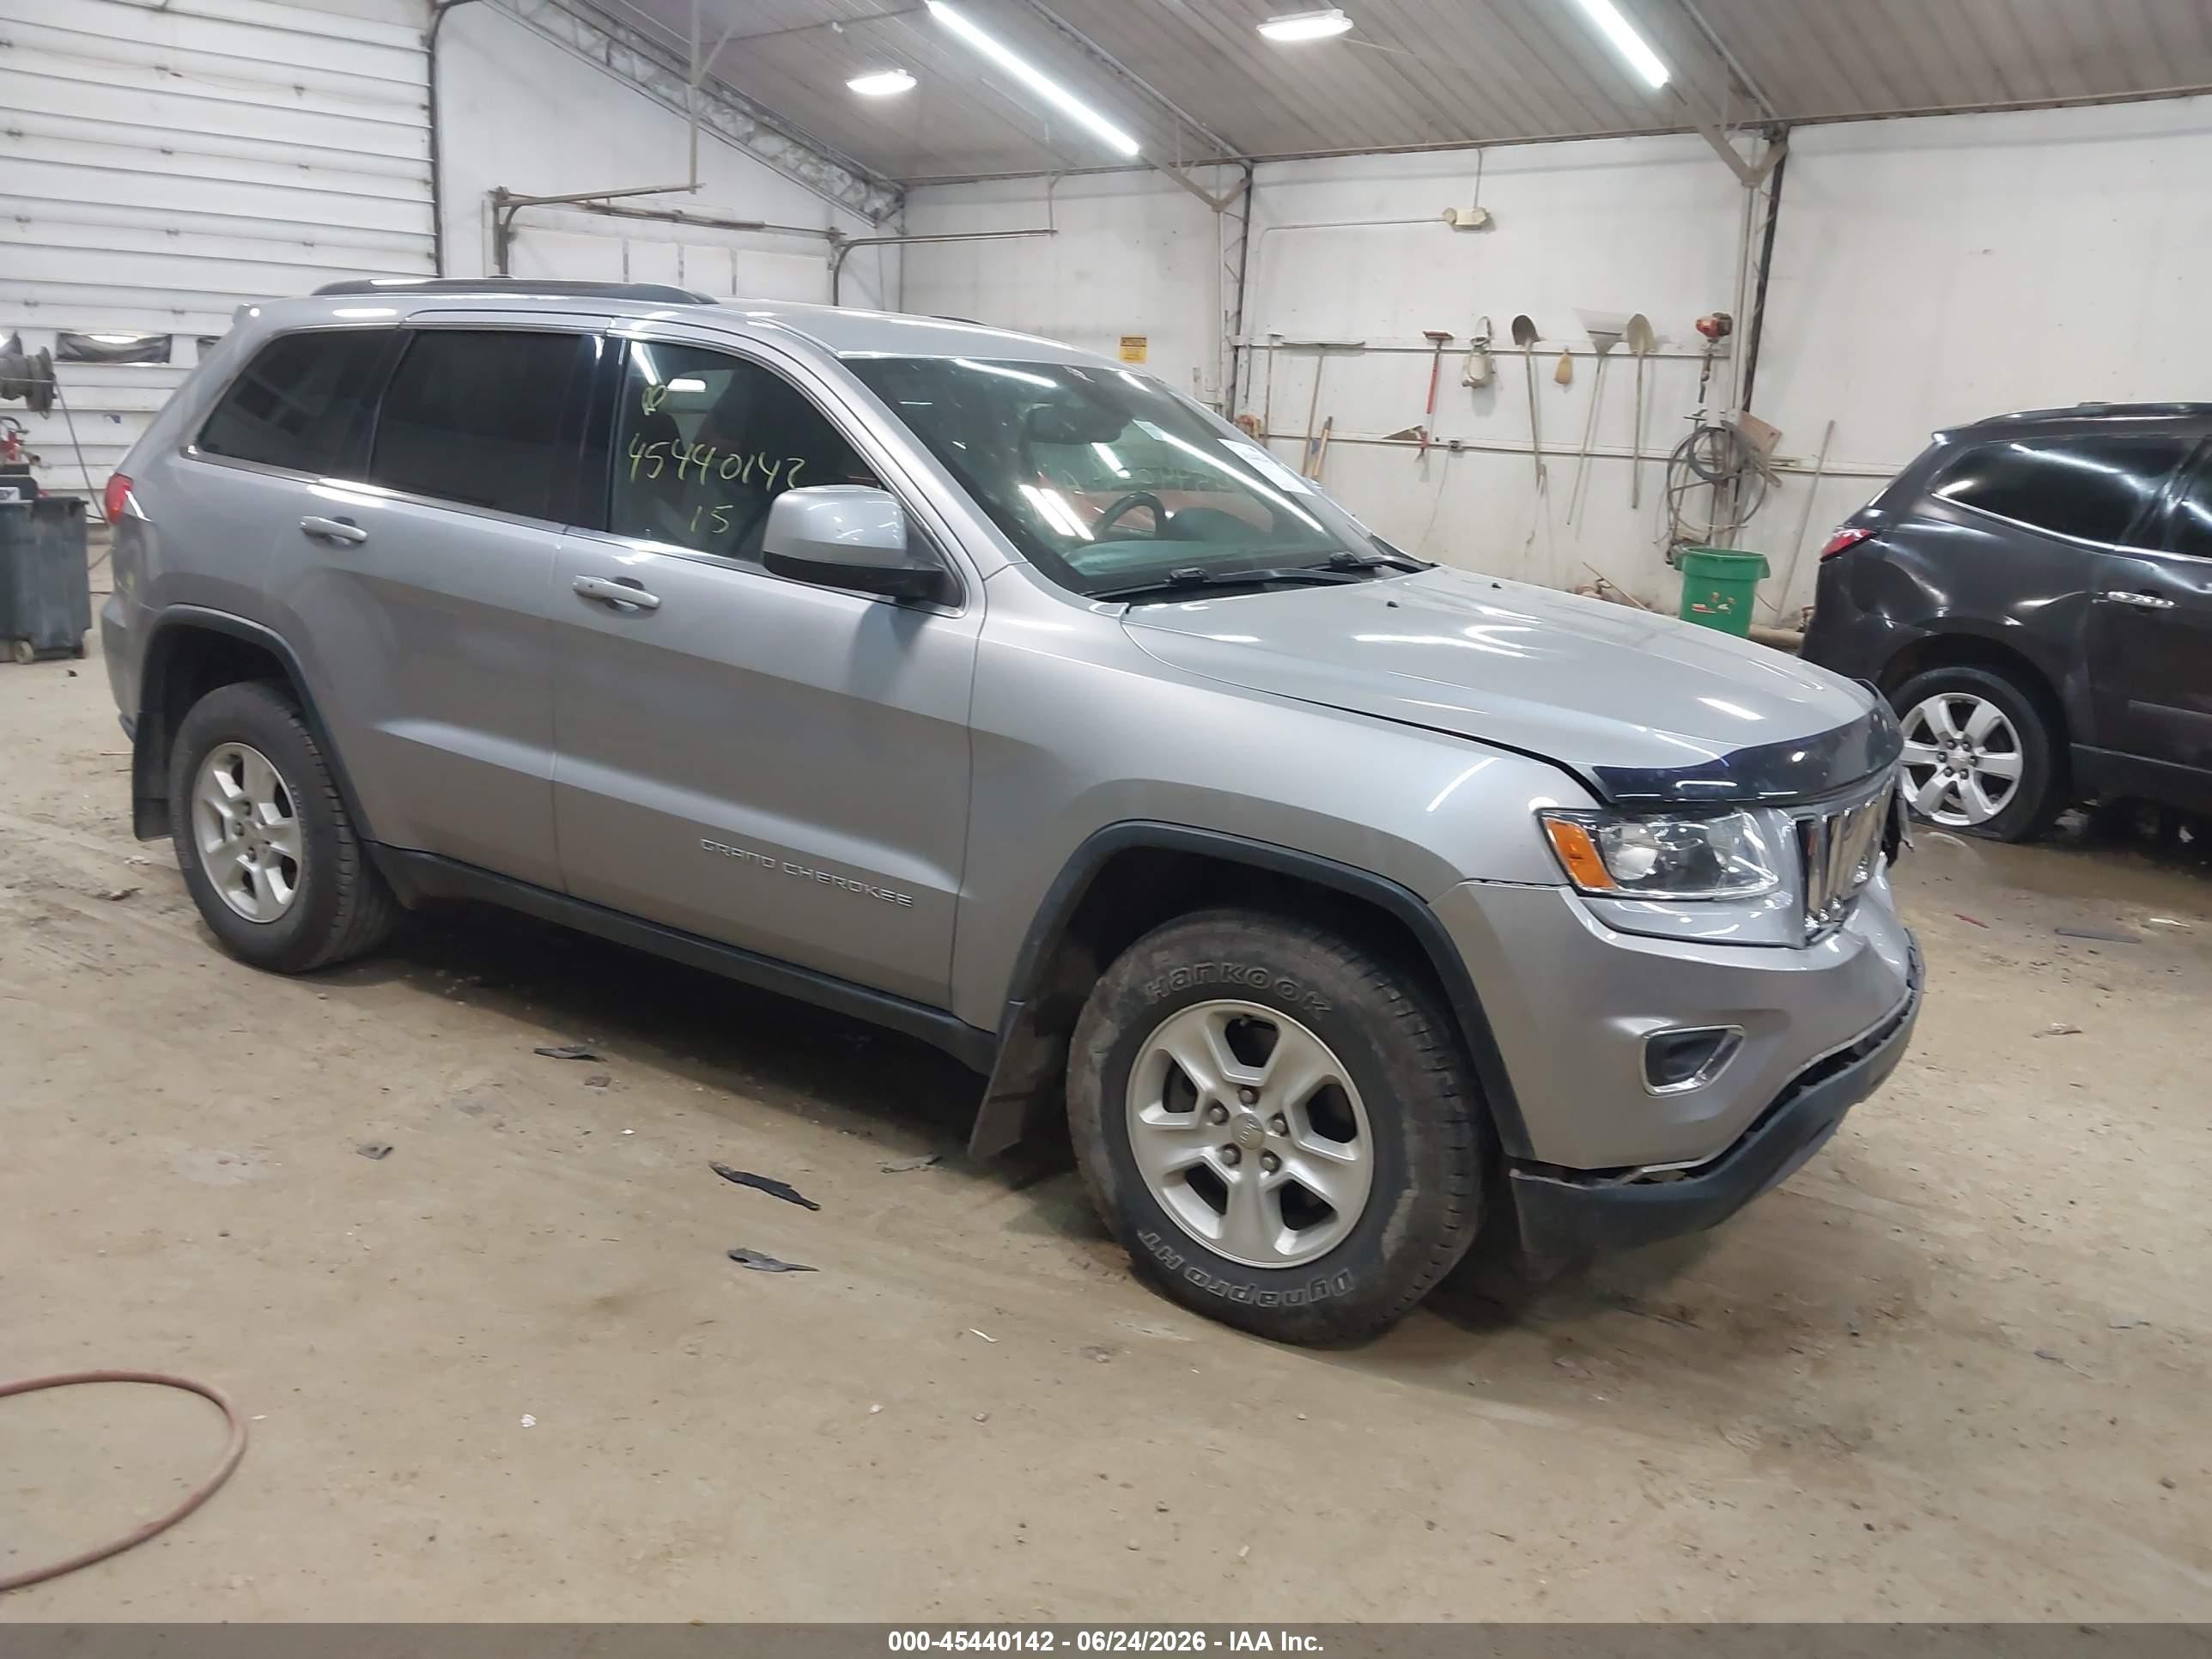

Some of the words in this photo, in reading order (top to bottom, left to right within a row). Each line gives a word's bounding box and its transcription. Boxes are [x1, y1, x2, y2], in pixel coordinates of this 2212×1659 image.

[628, 432, 805, 491] 45440142
[690, 505, 734, 533] 15
[700, 838, 776, 869] GRAND
[782, 861, 913, 907] CHEROKEE
